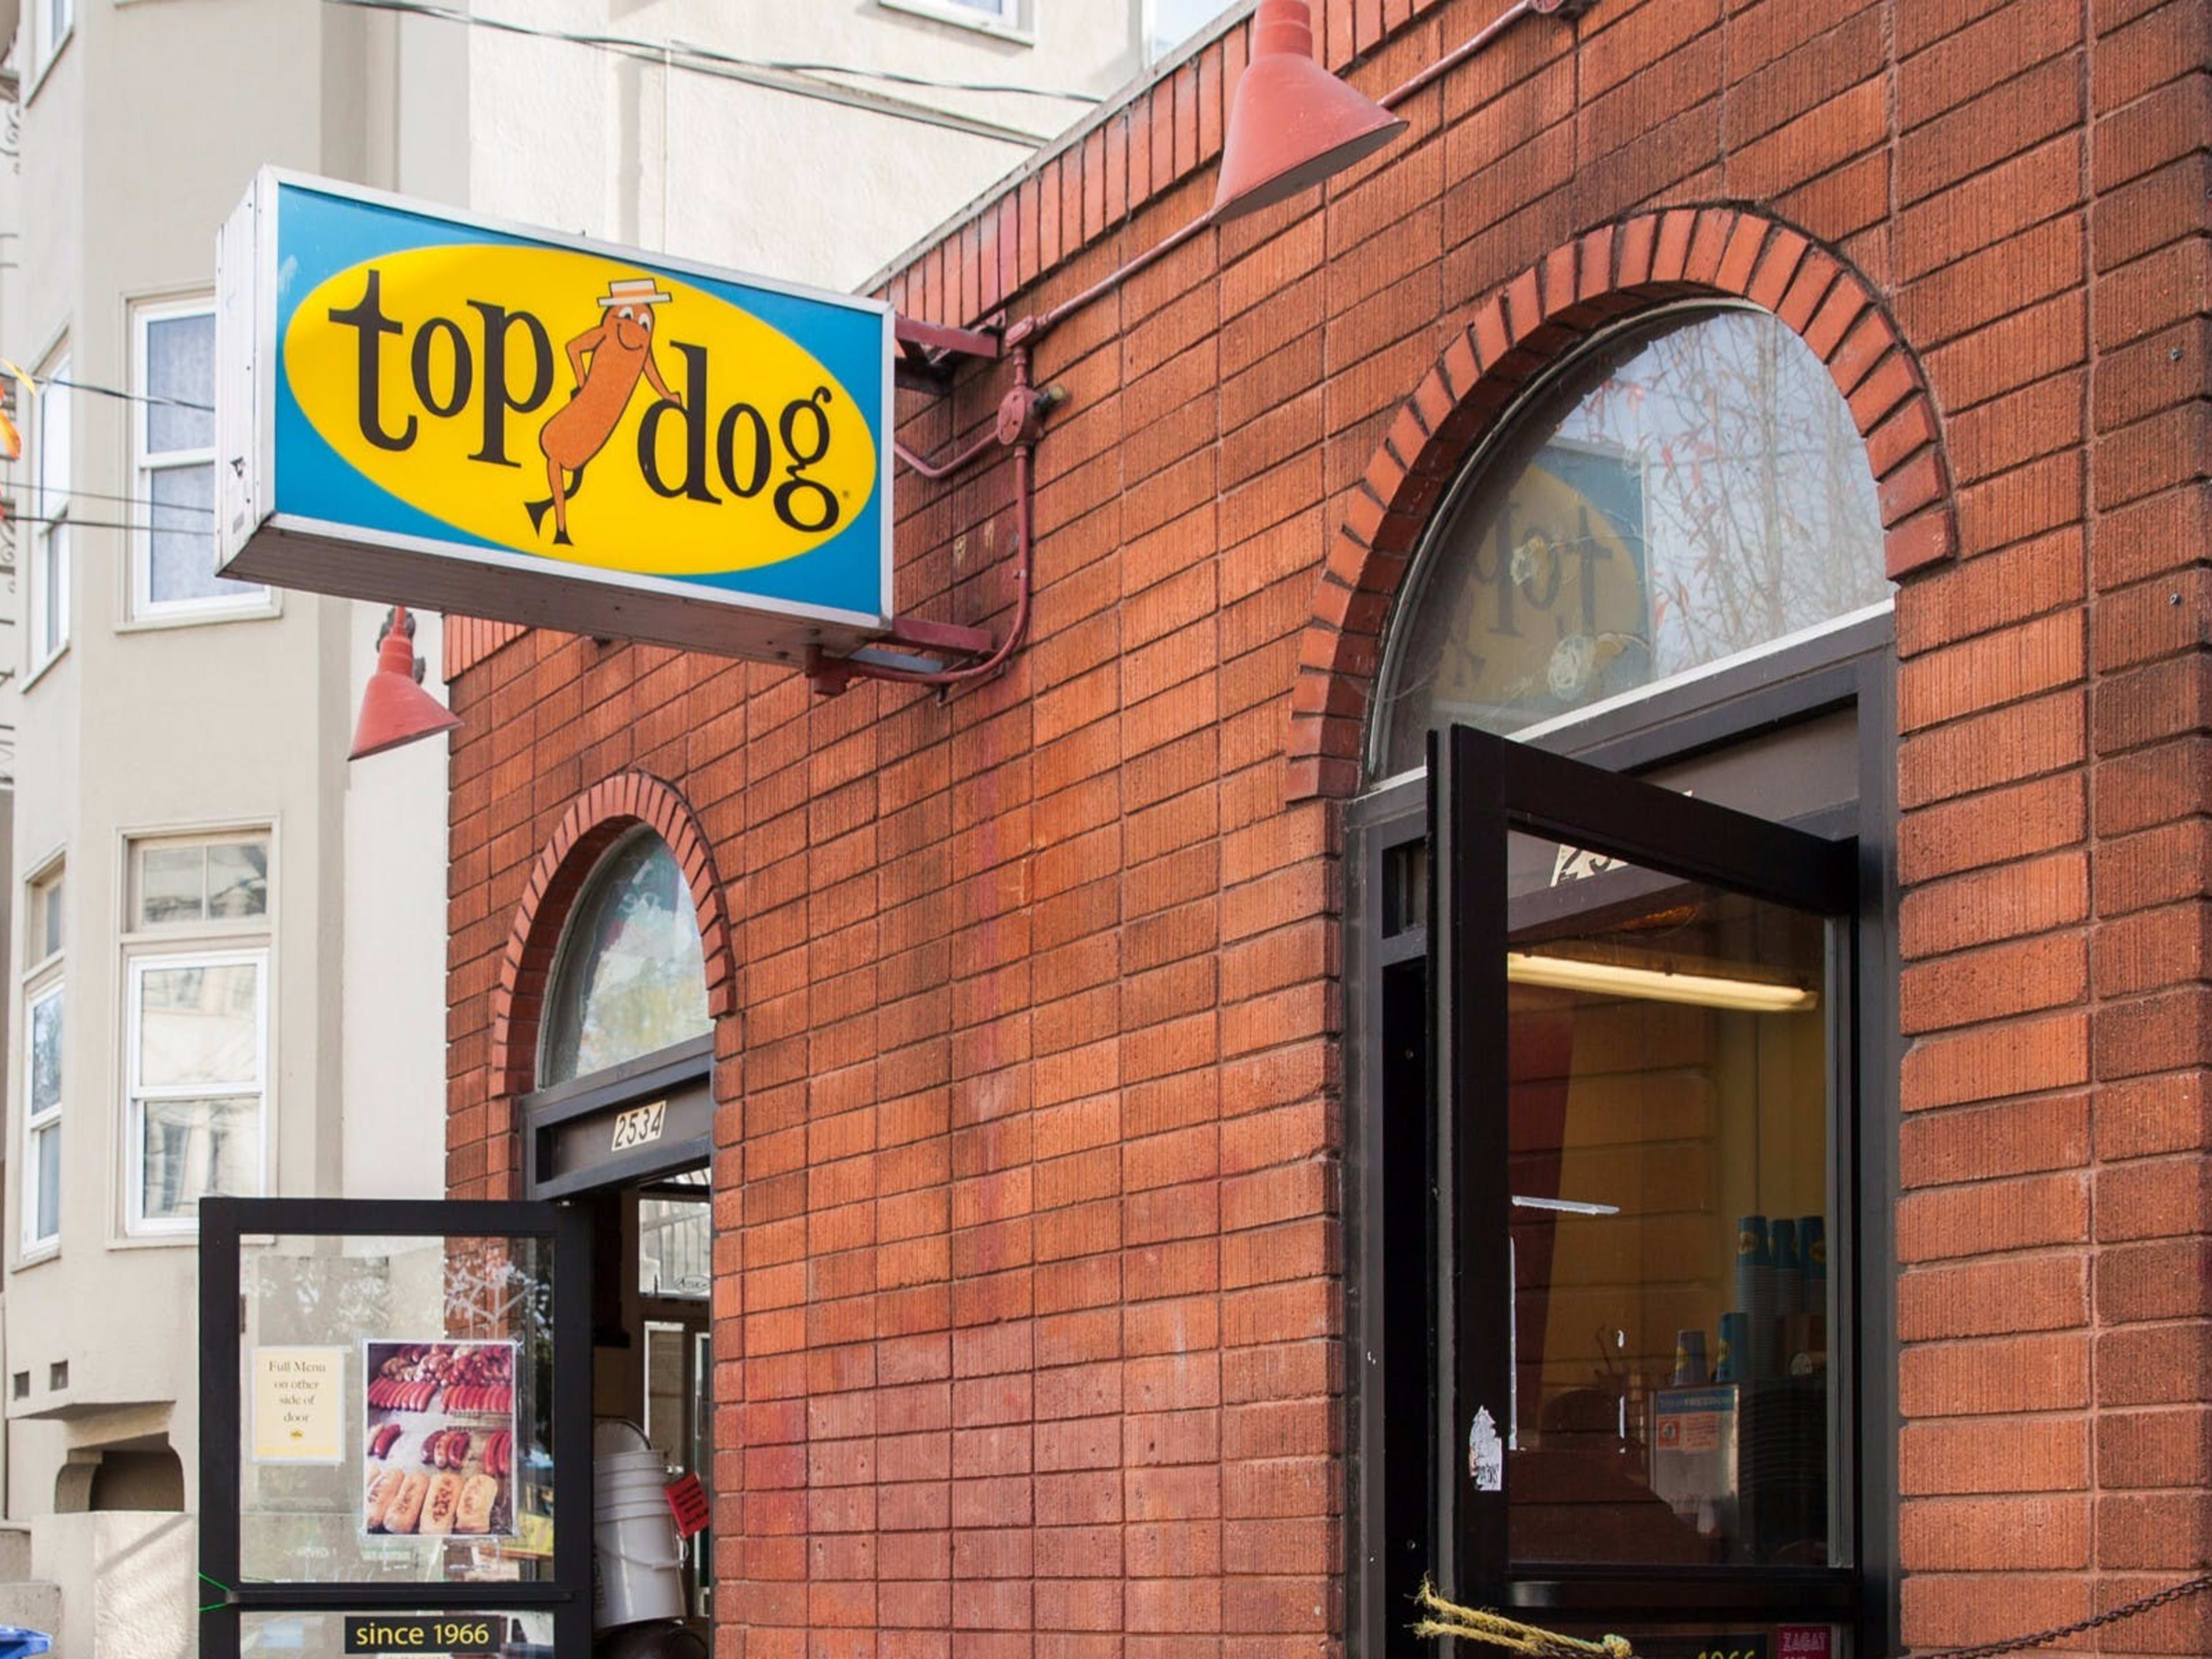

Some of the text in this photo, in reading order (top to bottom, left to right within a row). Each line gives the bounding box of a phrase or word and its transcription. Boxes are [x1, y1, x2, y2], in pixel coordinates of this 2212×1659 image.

[328, 270, 839, 533] top dog
[615, 1105, 664, 1147] 2534
[269, 1361, 326, 1372] Full Menu
[290, 1379, 319, 1389] other
[279, 1395, 316, 1405] side of
[283, 1411, 309, 1422] door
[356, 1622, 489, 1645] since 1966
[1784, 1632, 1826, 1652] ZAGAT
